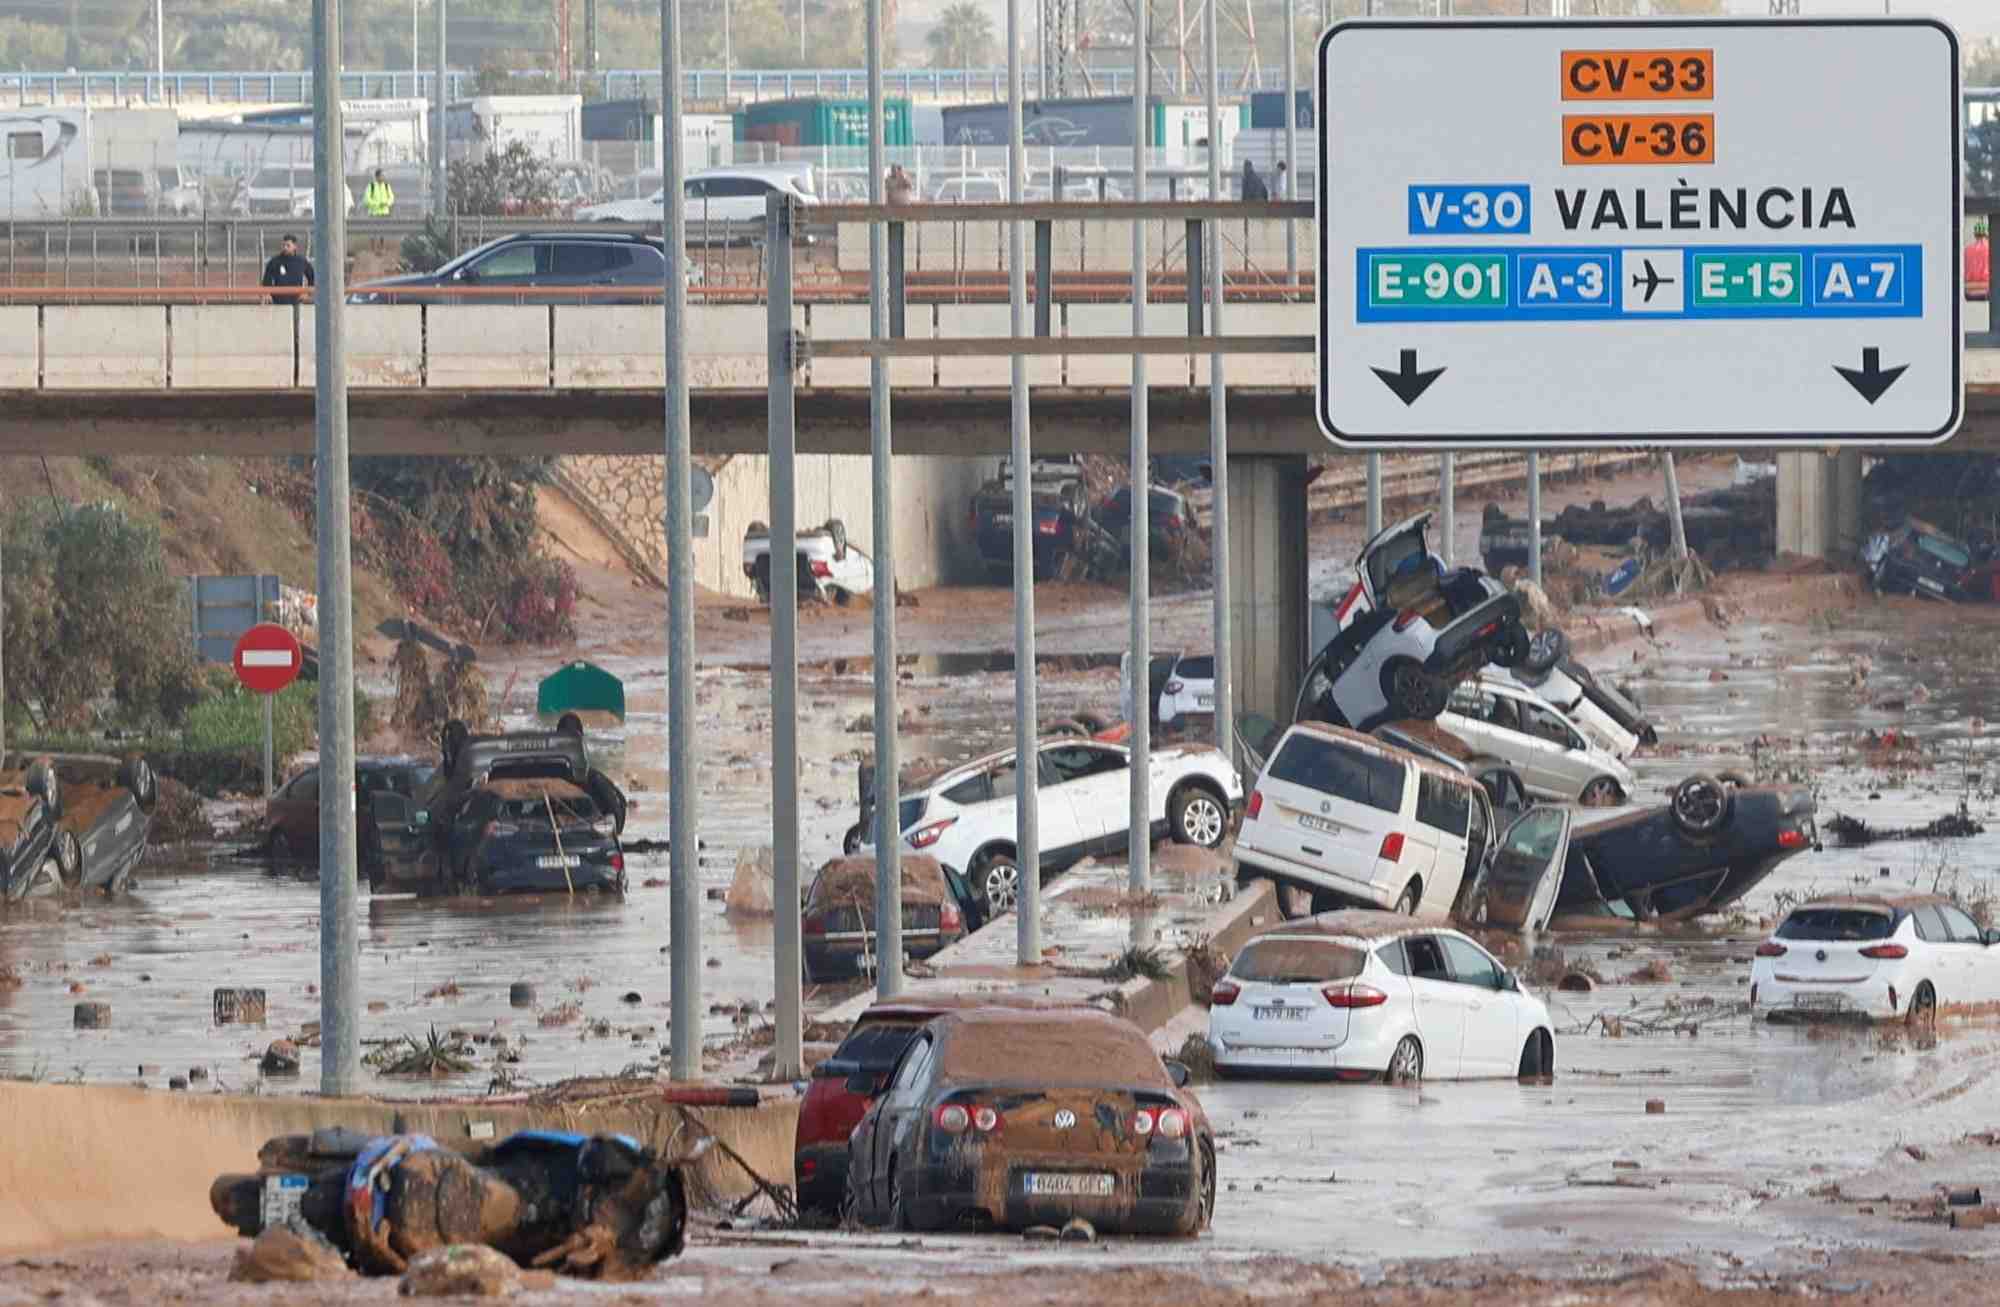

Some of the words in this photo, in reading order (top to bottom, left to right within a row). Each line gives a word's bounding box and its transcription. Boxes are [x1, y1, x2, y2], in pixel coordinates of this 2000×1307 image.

[1570, 57, 1706, 93] CV-33
[1571, 121, 1707, 157] CV-36
[1418, 191, 1523, 228] V-30
[1554, 178, 1856, 230] VALÈNCIA
[1378, 263, 1501, 299] E-901
[1527, 263, 1603, 298] A-3
[1701, 263, 1794, 297] E-15
[1823, 263, 1896, 298] A-7
